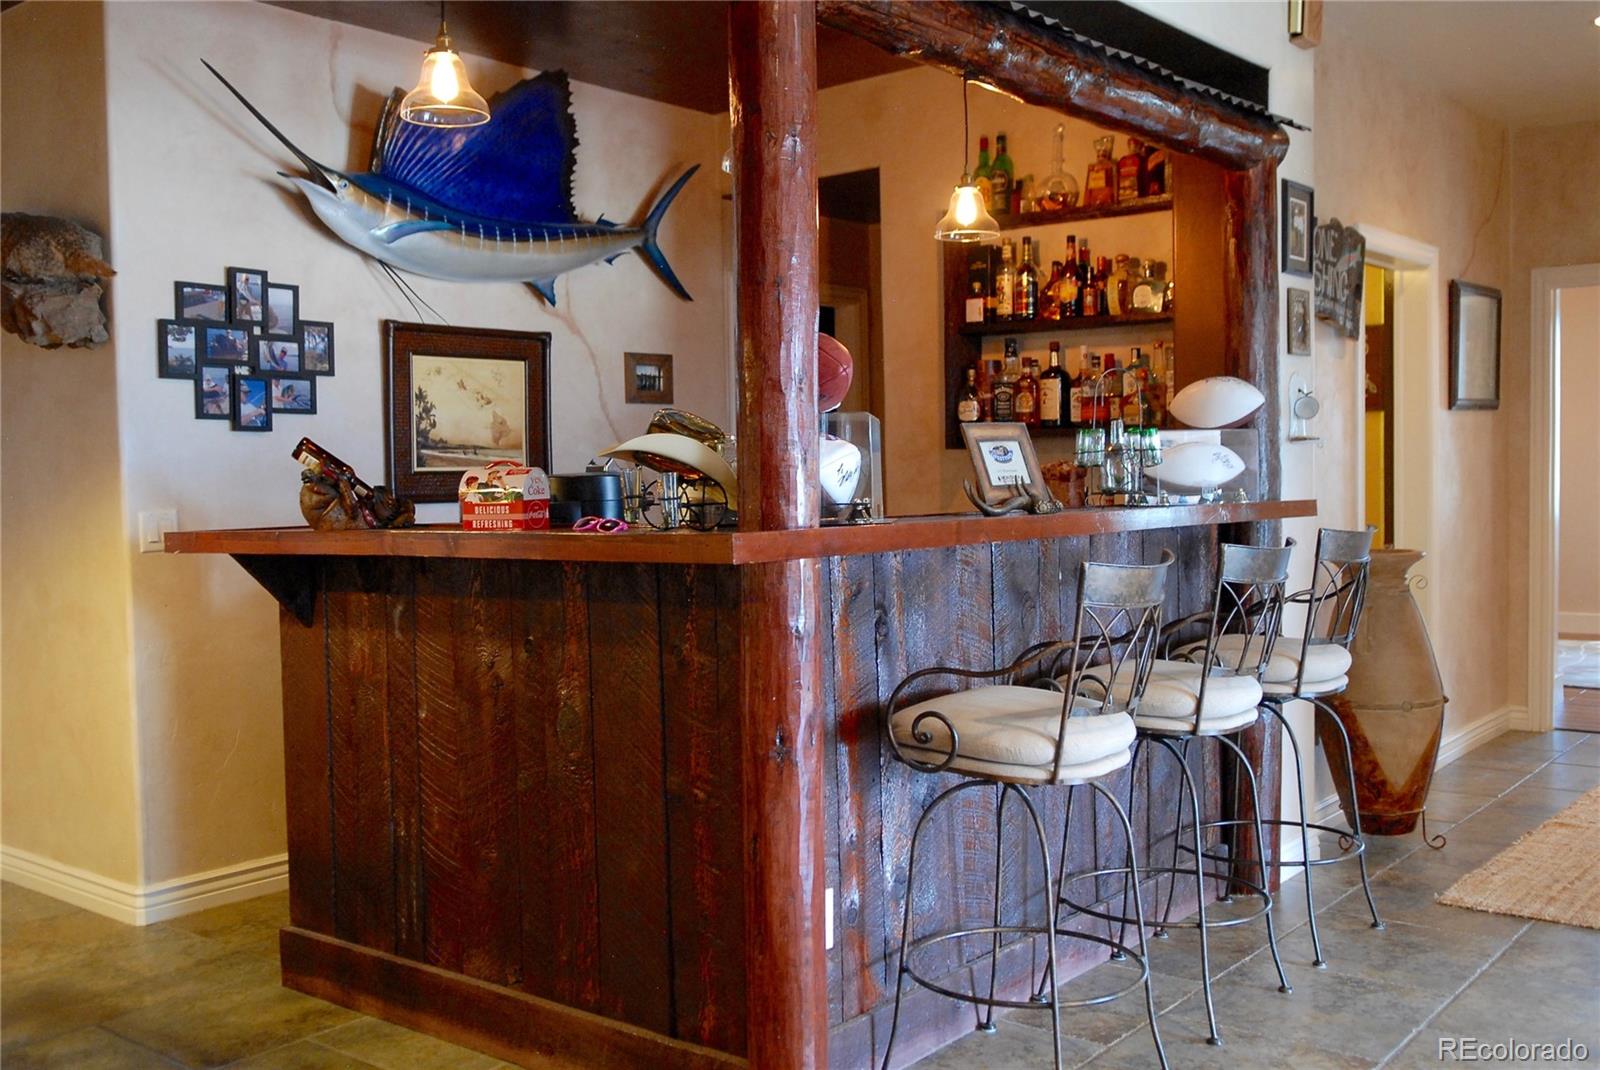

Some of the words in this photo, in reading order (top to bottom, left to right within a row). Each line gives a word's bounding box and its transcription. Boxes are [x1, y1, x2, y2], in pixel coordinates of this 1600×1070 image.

[1313, 226, 1337, 263] ONE
[1313, 258, 1348, 301] SHING
[474, 505, 510, 514] DELICIOUS
[472, 519, 513, 528] REFRESHING
